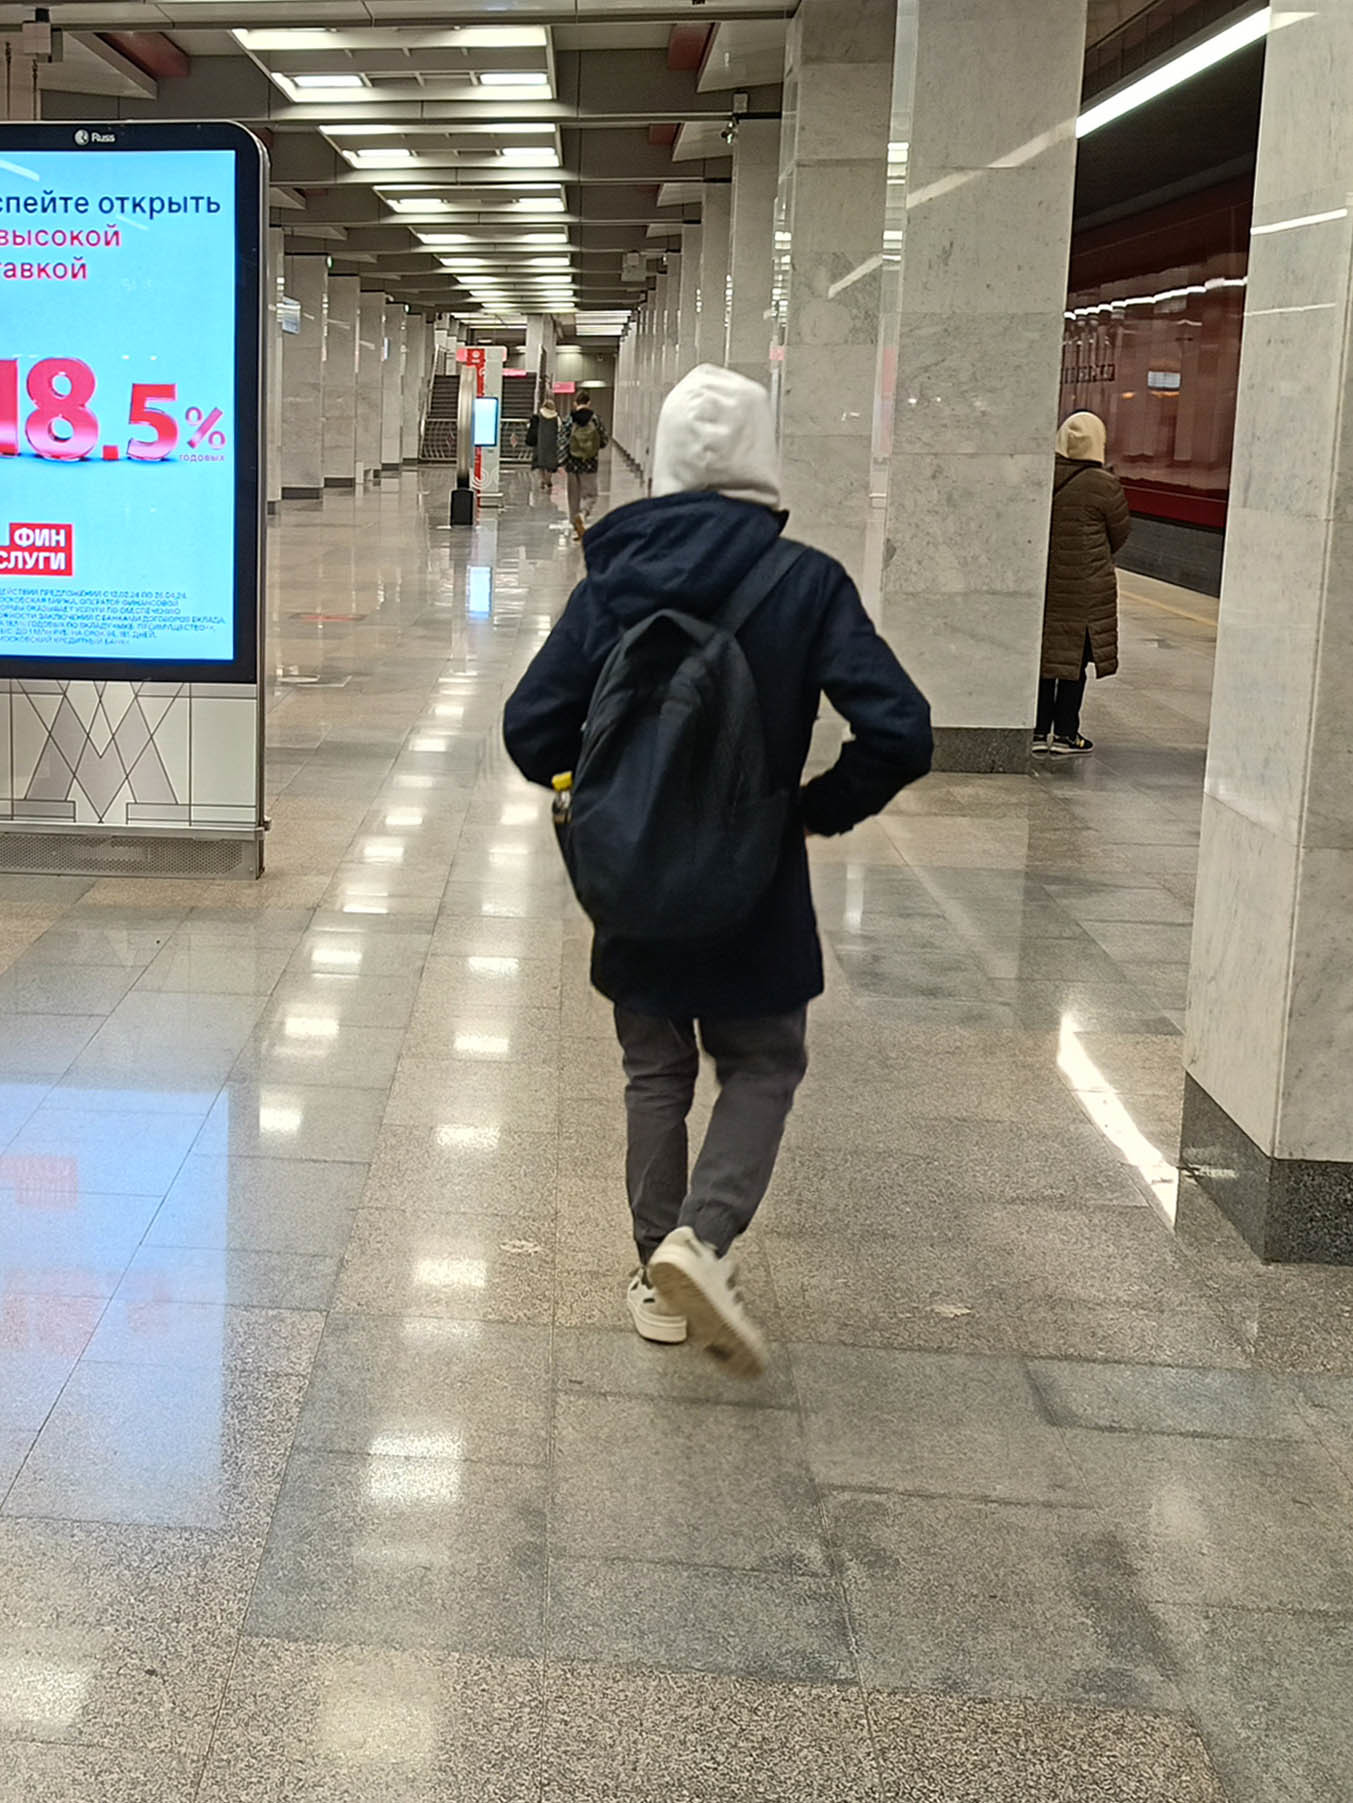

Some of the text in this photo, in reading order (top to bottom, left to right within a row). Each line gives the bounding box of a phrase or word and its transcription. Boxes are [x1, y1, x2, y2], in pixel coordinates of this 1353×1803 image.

[91, 132, 116, 143] Russ
[98, 194, 221, 219] открыть
[13, 528, 66, 547] ФИН
